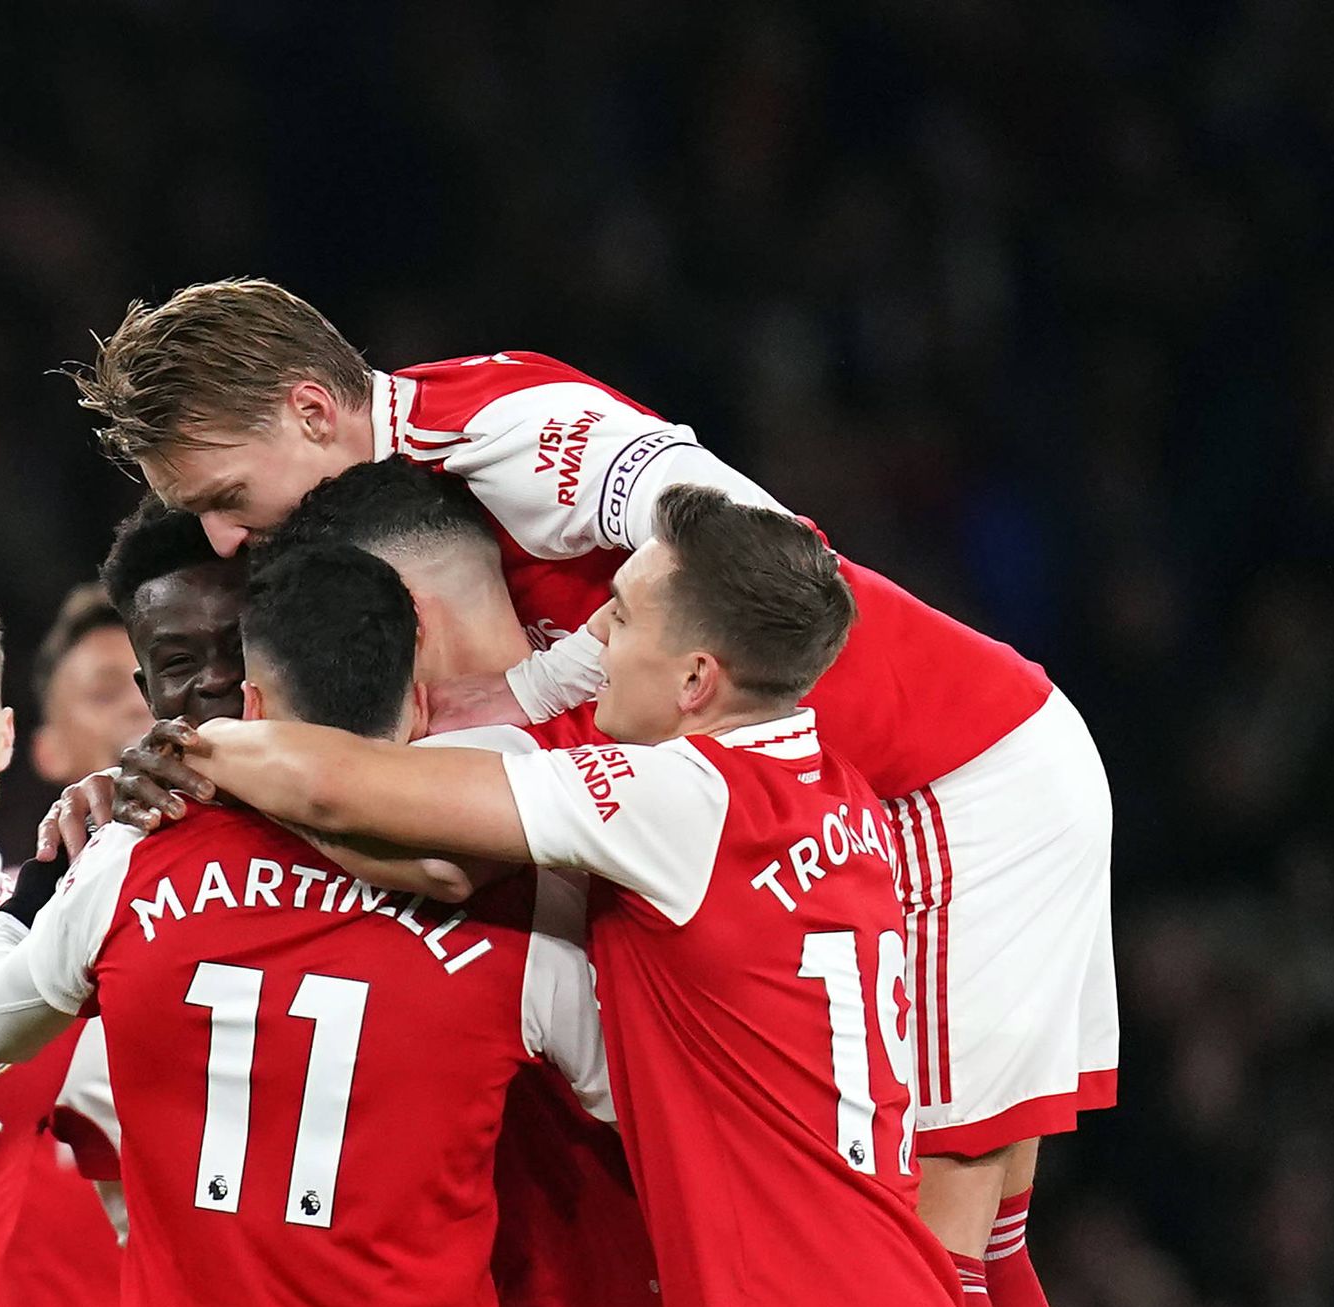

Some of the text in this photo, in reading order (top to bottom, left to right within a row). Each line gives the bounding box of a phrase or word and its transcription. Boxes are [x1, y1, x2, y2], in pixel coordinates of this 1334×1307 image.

[534, 418, 569, 474] VISIT
[557, 410, 607, 507] RWANDA
[607, 434, 675, 537] captain
[597, 744, 635, 779] ISIT
[182, 961, 370, 1229] 11
[796, 929, 917, 1177] 19
